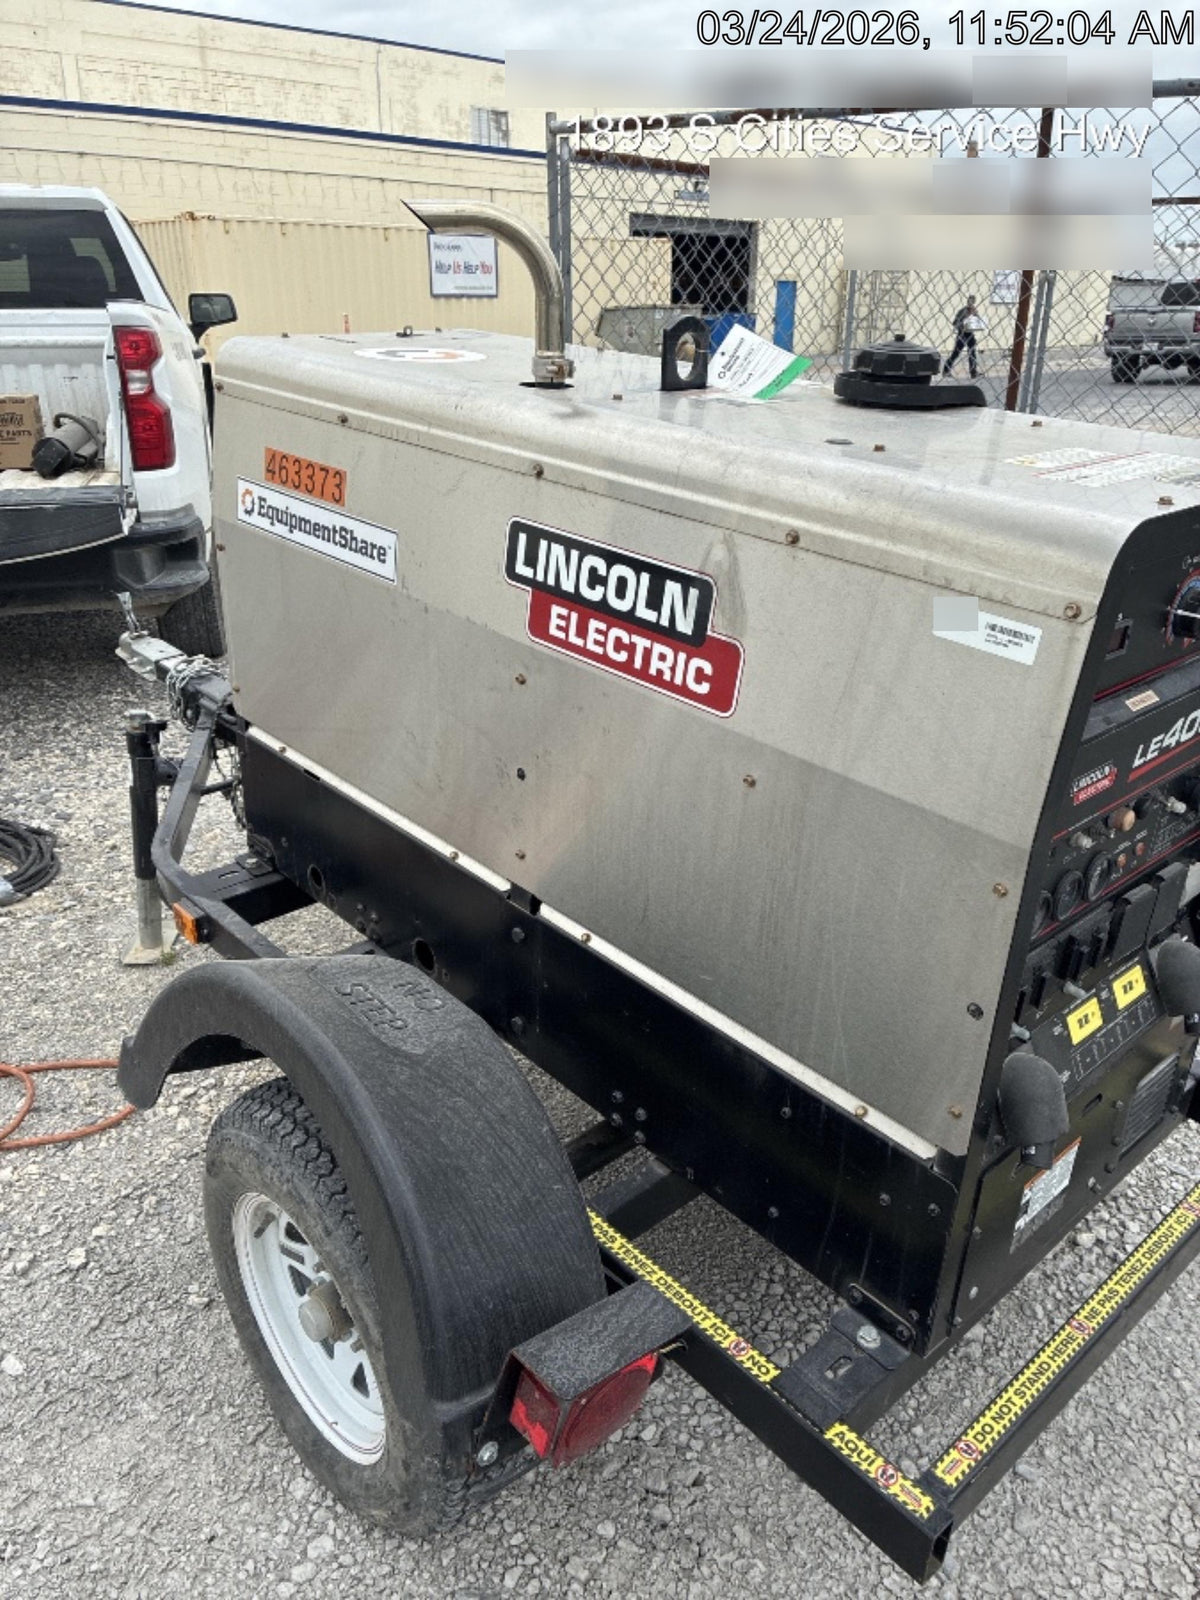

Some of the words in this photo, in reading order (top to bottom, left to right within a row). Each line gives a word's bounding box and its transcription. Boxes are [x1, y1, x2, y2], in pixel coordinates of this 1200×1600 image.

[265, 453, 343, 504] 463373
[257, 496, 388, 564] EquipmentShare
[515, 532, 700, 635] LINCOLN
[549, 604, 713, 695] ELECTRIC
[1132, 709, 1200, 769] LE40
[618, 1240, 657, 1278] TENEZ
[656, 1276, 712, 1322] DEBOUT
[709, 1322, 731, 1341] ICI
[746, 1354, 770, 1376] NO
[1084, 1305, 1101, 1324] NE
[1100, 1287, 1119, 1309] PAS
[1115, 1258, 1146, 1289] TENEZ
[1141, 1226, 1177, 1261] DEBOUT
[1174, 1213, 1189, 1228] ICI
[973, 1423, 995, 1444] DO
[991, 1398, 1017, 1425] NOT
[1013, 1361, 1051, 1400] STAND
[1046, 1331, 1081, 1363] HERE
